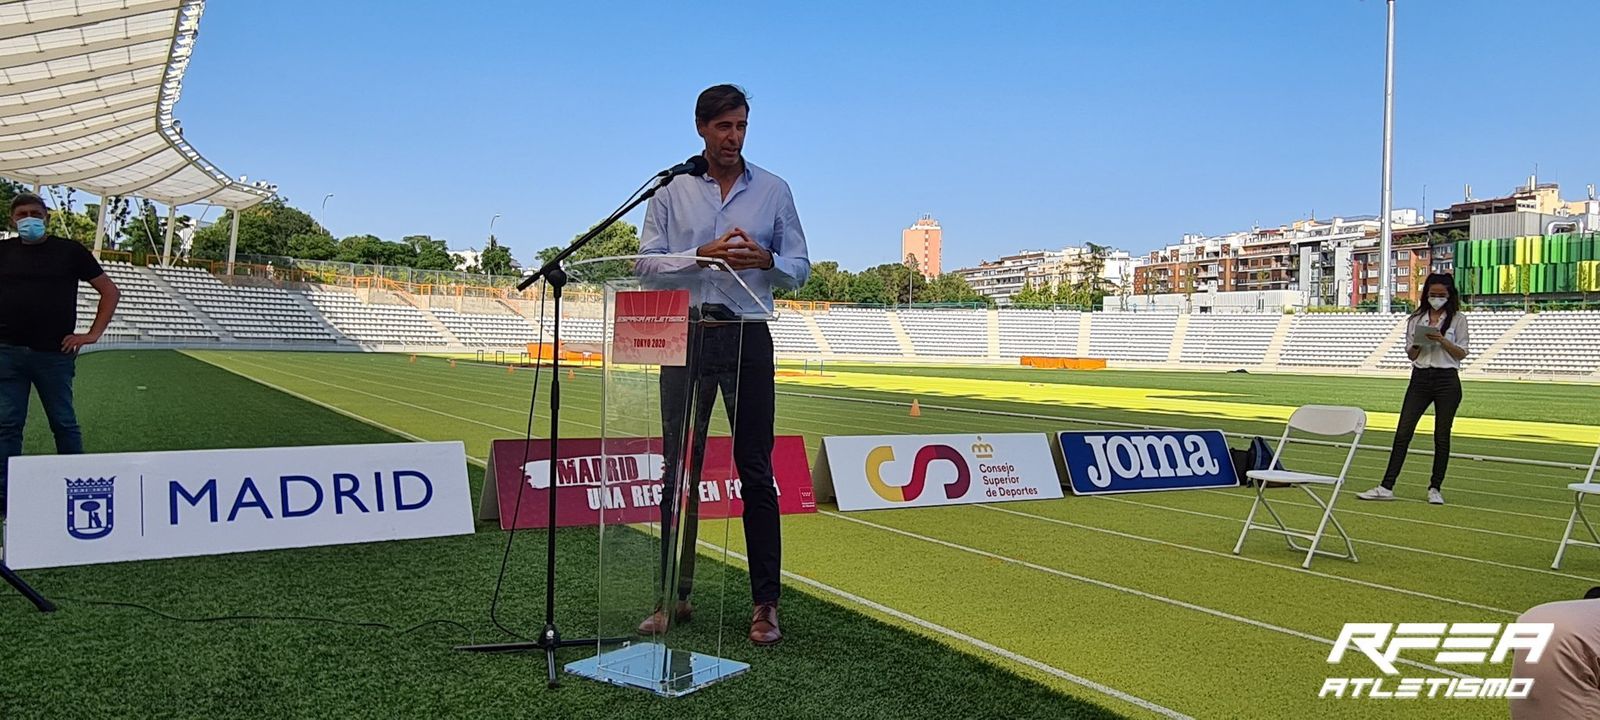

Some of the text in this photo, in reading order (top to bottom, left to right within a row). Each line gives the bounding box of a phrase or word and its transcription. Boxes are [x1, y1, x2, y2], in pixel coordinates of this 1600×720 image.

[634, 338, 666, 348] TOKYO 2020
[557, 456, 639, 485] MADRID
[979, 462, 1015, 477] Consejo
[982, 475, 1020, 487] Superior
[168, 470, 434, 526] MADRID
[586, 486, 627, 510] UNA
[698, 480, 721, 503] EN
[985, 486, 1038, 499] de Deportes
